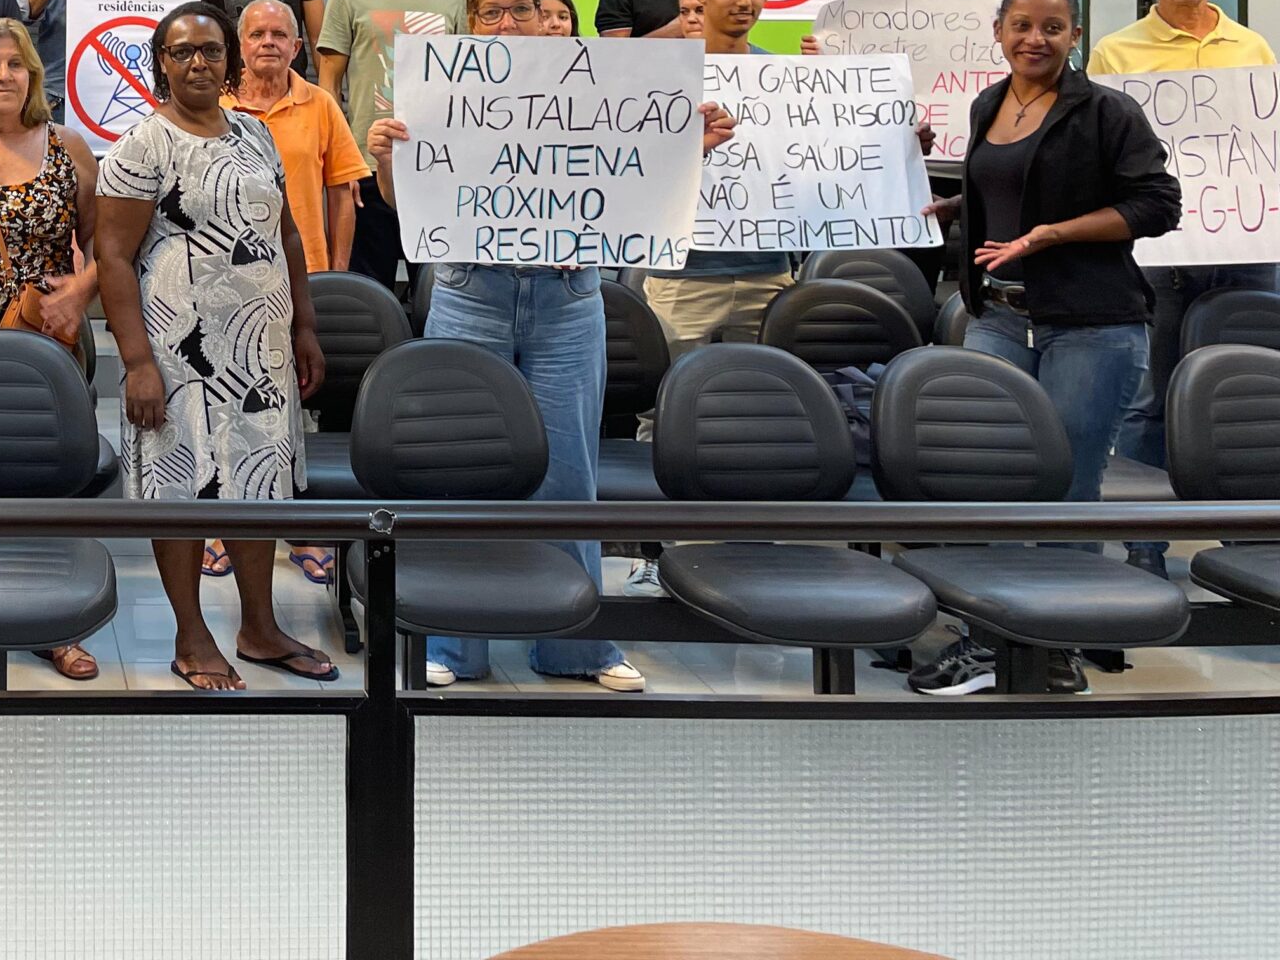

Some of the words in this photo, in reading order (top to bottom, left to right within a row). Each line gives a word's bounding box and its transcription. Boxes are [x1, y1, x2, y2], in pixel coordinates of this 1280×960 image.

[98, 0, 165, 12] residências
[822, 0, 981, 31] Moradores
[424, 36, 512, 84] NÃO
[560, 38, 595, 85] À
[703, 64, 741, 91] EM
[759, 64, 897, 94] GARANTE
[1249, 72, 1279, 120] U
[786, 97, 820, 127] HÁ
[832, 100, 916, 127] RISCO?
[416, 140, 454, 173] DA
[489, 143, 644, 177] ANTENA
[703, 142, 761, 171] SSA
[784, 138, 883, 171] SAÚDE
[1160, 124, 1277, 178] ISTÂN
[456, 175, 605, 221] PRÓXIMO
[771, 174, 795, 210] É
[818, 182, 868, 210] UM
[415, 226, 450, 259] AS
[475, 224, 688, 265] RESIDÊNCIAS
